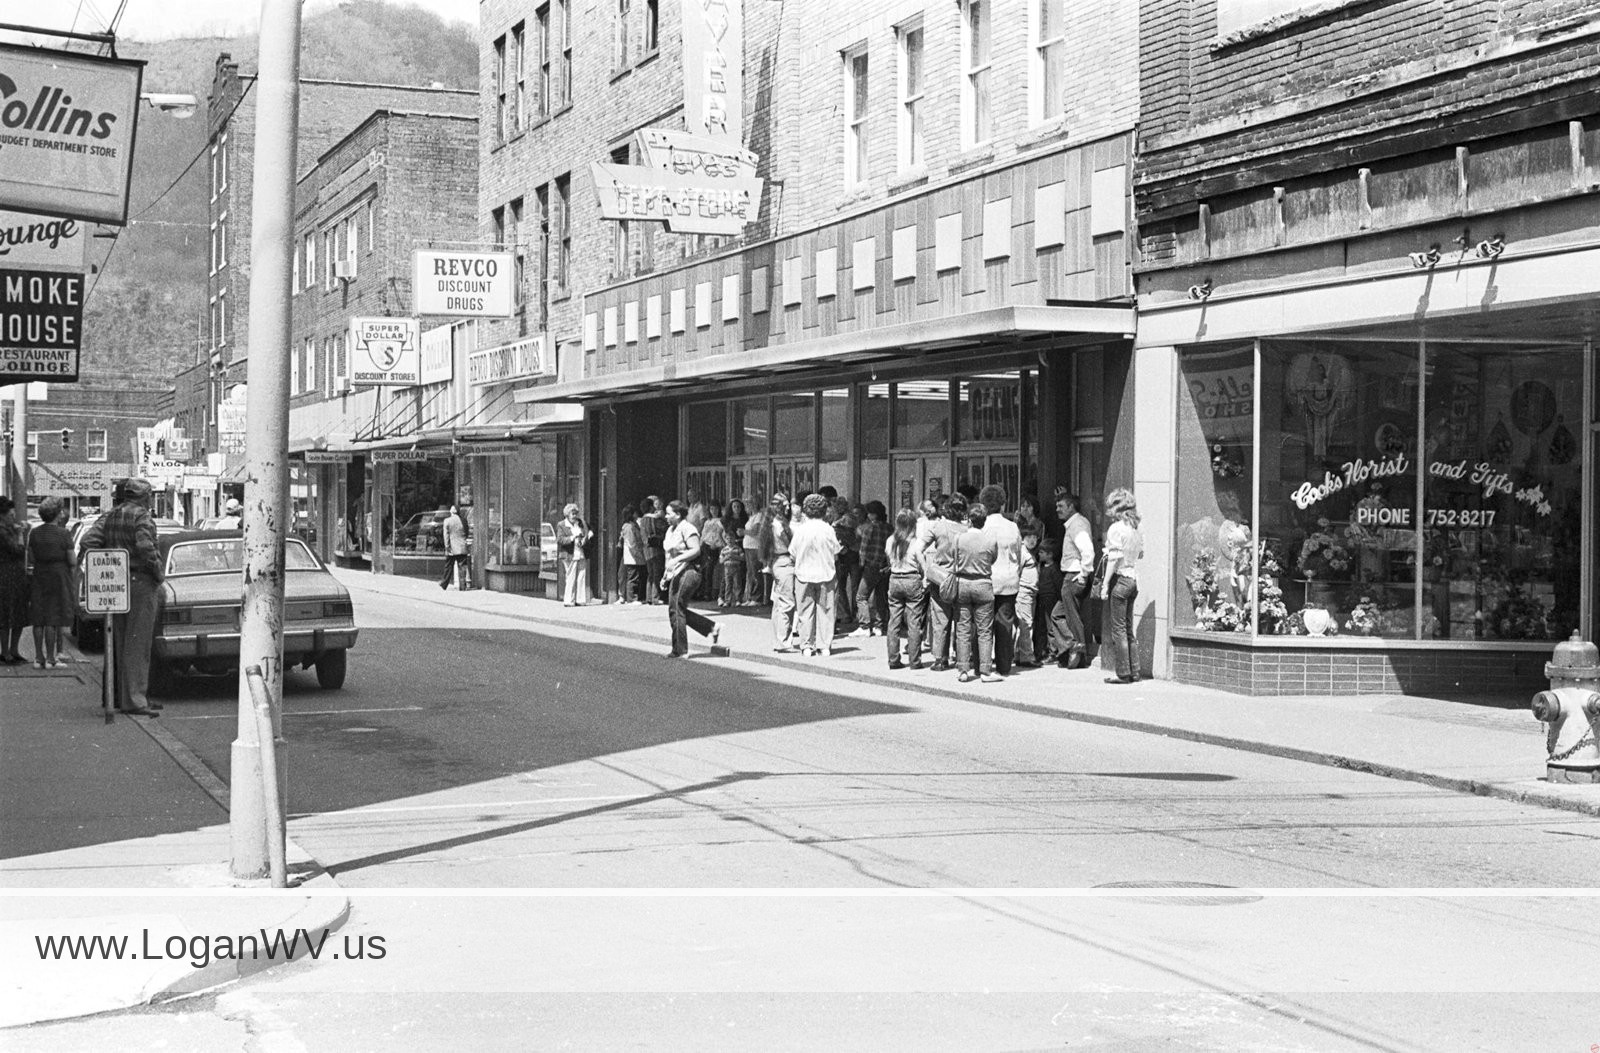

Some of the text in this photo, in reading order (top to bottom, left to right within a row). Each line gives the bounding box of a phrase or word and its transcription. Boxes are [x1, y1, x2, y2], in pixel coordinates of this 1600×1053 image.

[0, 135, 117, 158] UDGET DEPARTMENT STORE
[0, 219, 79, 254] unge
[433, 258, 498, 278] REVCO
[6, 276, 79, 305] MOKE
[438, 280, 492, 293] DISCOUNT
[447, 297, 483, 310] DRUGS
[368, 324, 400, 332] SUPER
[365, 332, 404, 340] DOLLAR
[390, 373, 416, 381] STORES
[374, 450, 426, 460] SUPER DOLLAR
[1290, 452, 1514, 510] Cook's Florist and Gifts
[1358, 508, 1410, 524] PHONE
[93, 557, 122, 566] LOADING
[100, 571, 115, 580] AND
[90, 584, 125, 593] UNLOADING
[99, 597, 116, 606] ZONE
